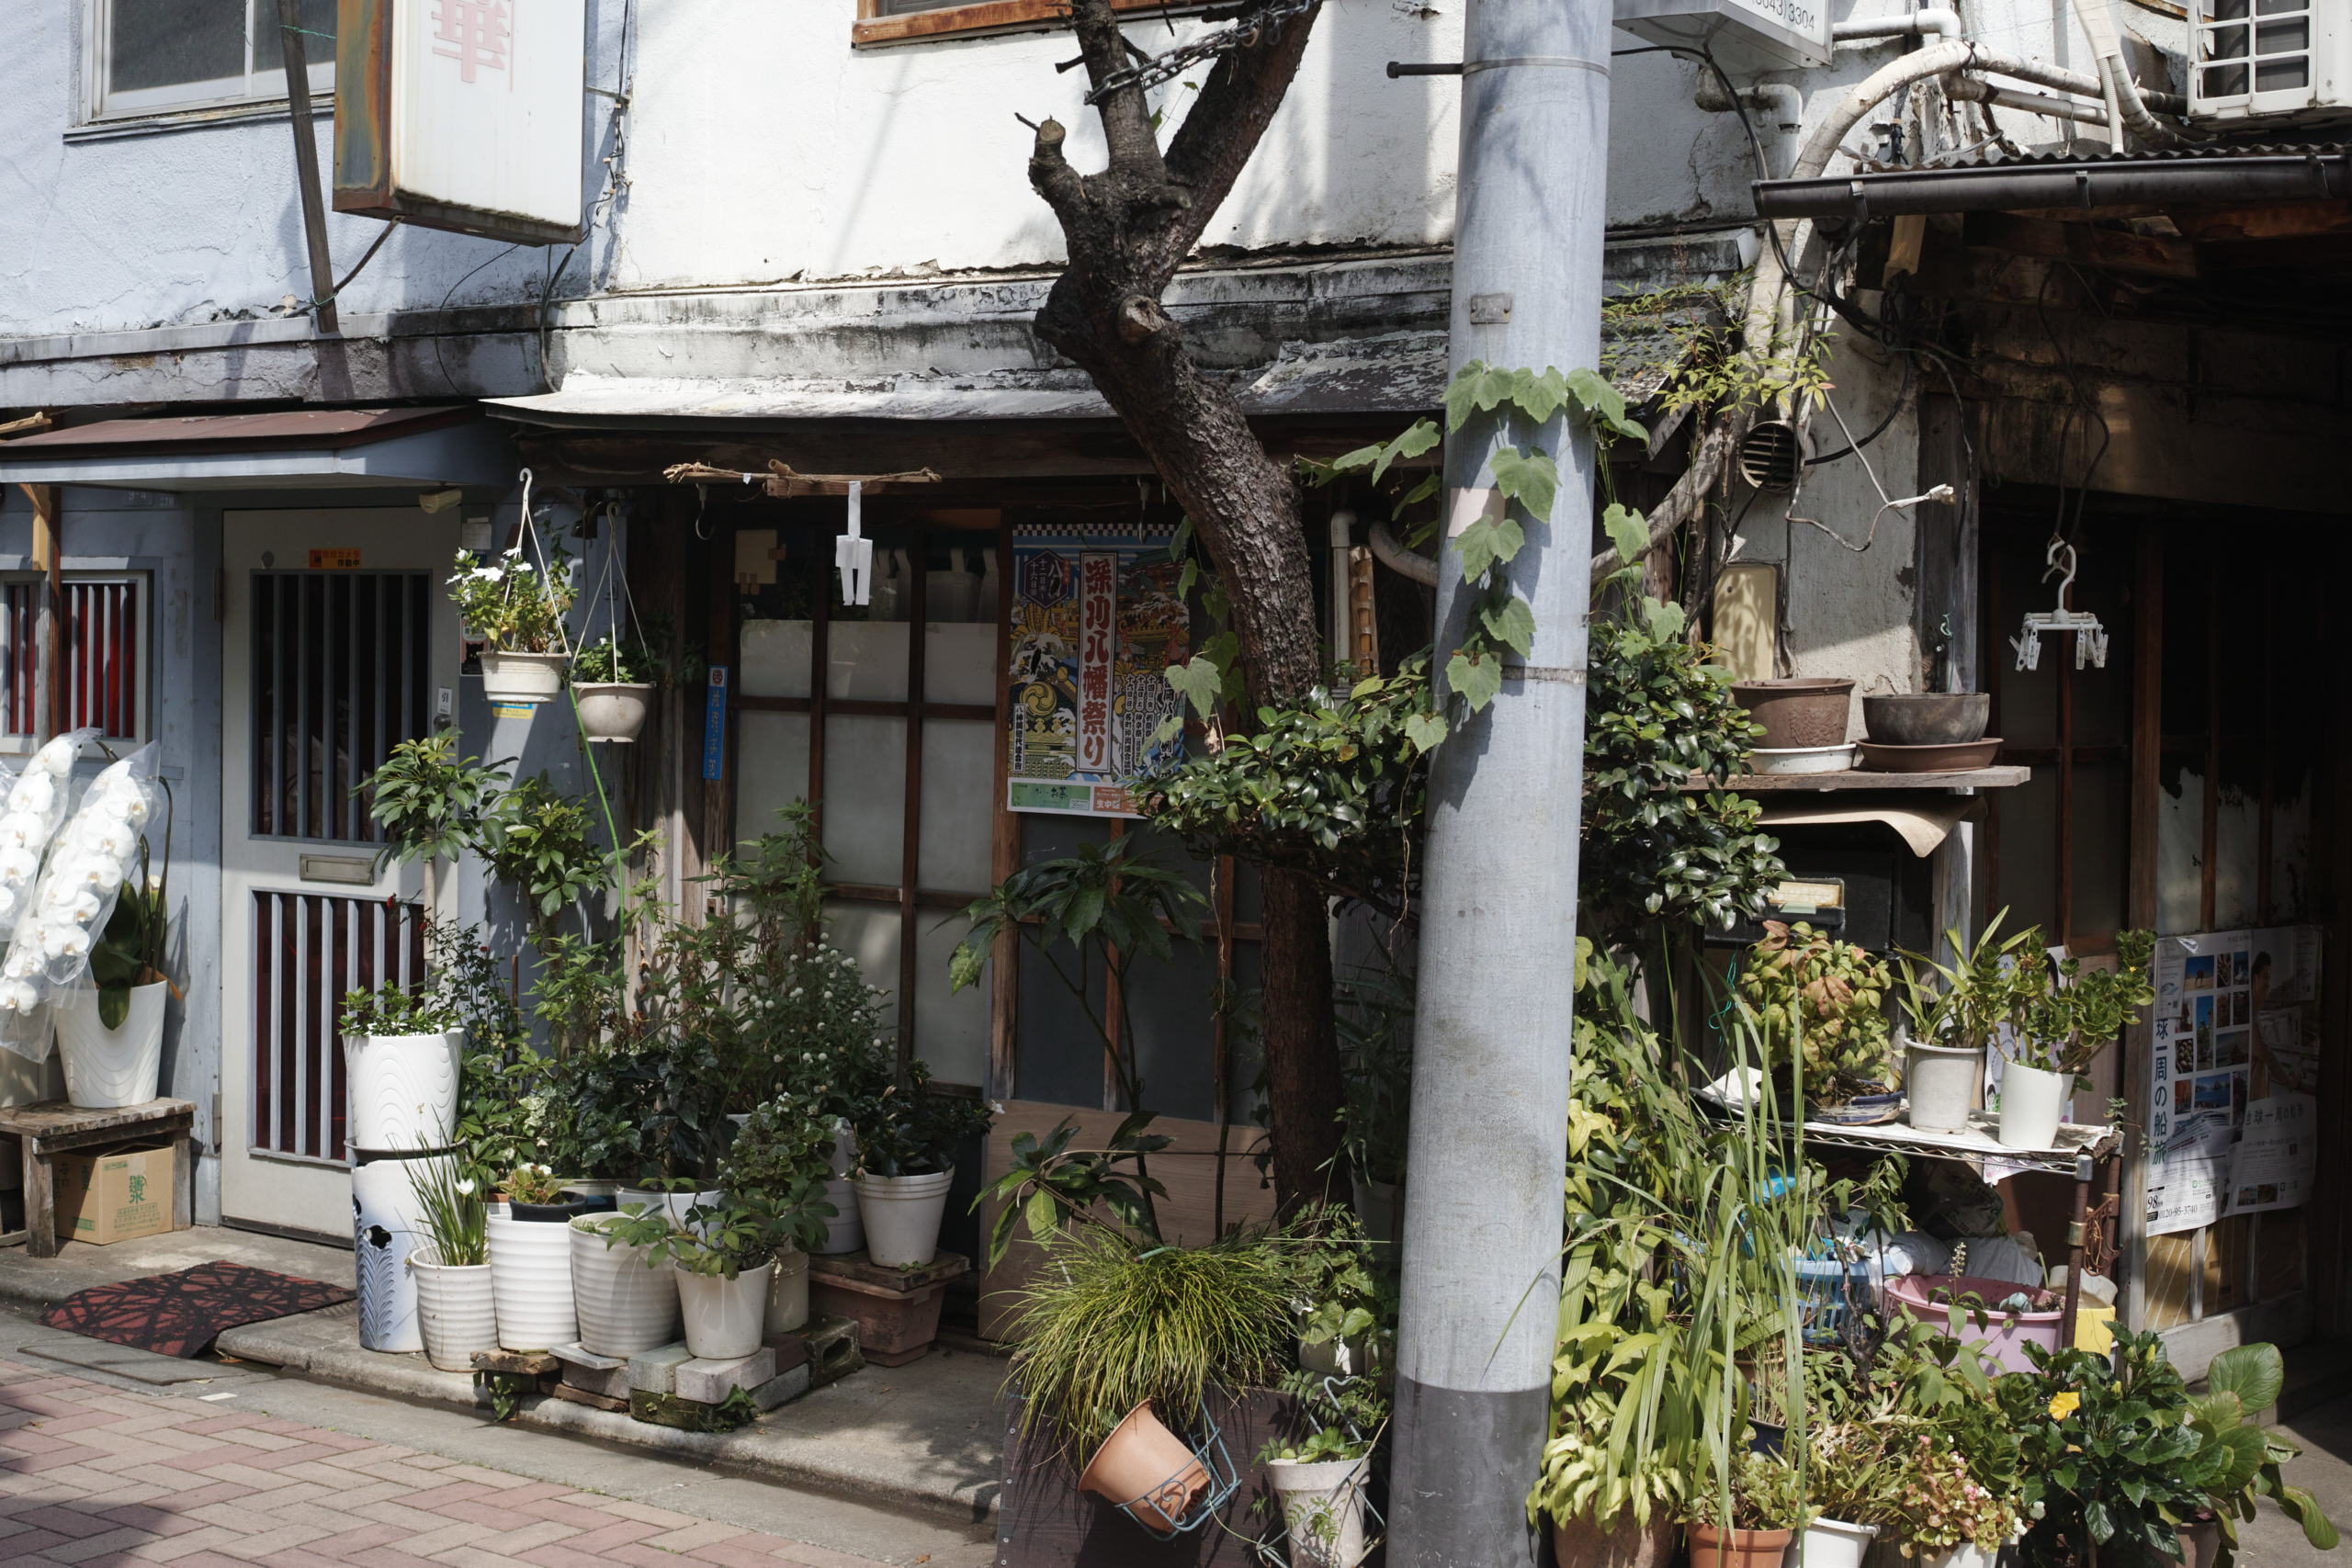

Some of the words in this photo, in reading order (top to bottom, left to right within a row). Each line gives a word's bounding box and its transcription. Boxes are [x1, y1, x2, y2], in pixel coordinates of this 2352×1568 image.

[1753, 0, 1815, 32] 43)3304
[160, 497, 174, 506] 二丁目
[322, 550, 359, 558] 防犯カメラ
[338, 558, 359, 567] 作動中
[1081, 558, 1113, 767] 深川八幡祭り
[442, 692, 448, 703] 引
